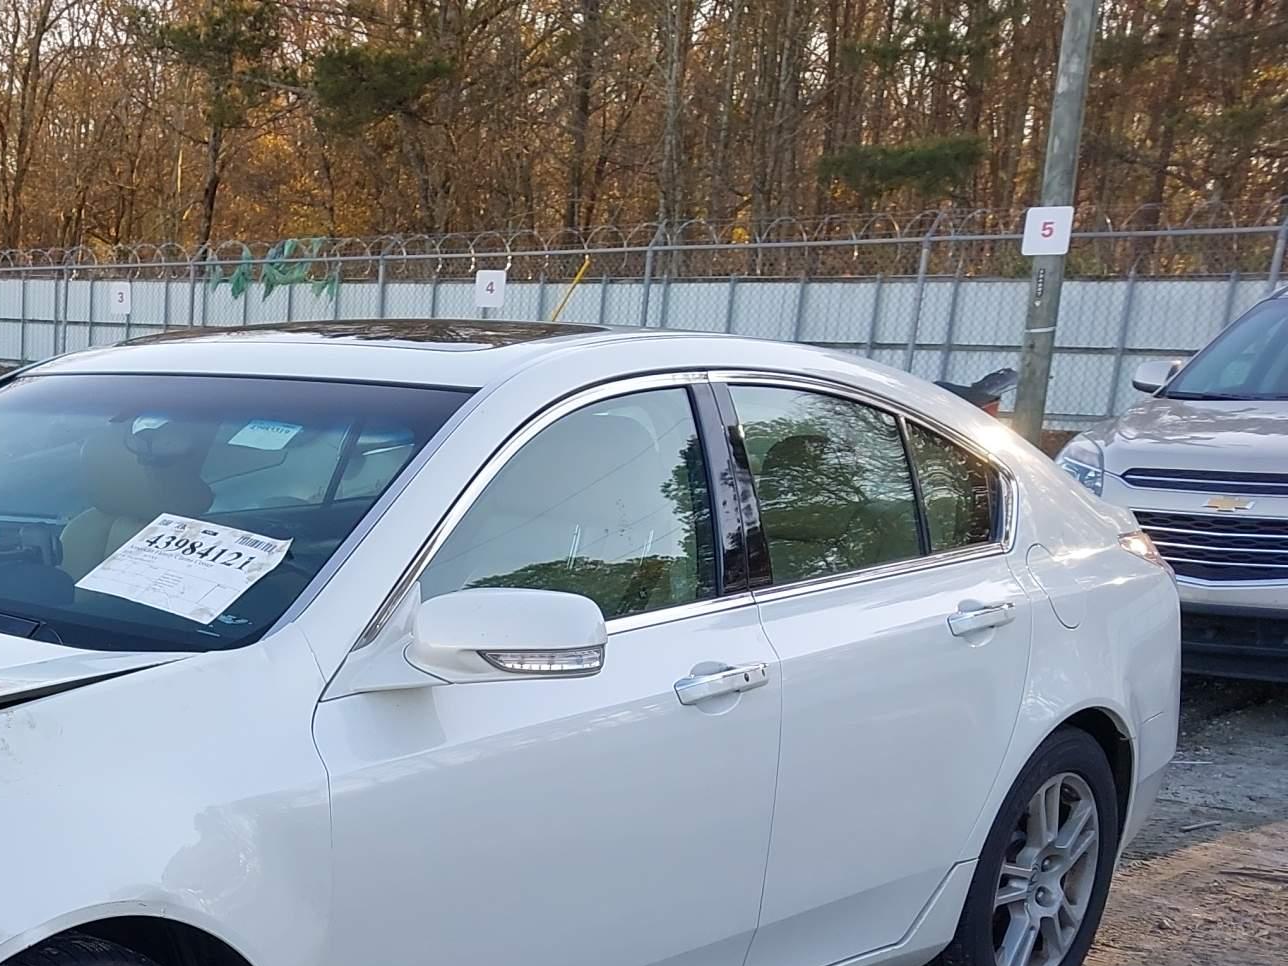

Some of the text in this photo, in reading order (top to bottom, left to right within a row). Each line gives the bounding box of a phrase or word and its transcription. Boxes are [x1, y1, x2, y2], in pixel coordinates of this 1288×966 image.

[1041, 221, 1054, 238] 5
[486, 281, 495, 294] 4
[117, 291, 124, 304] 3
[145, 533, 256, 570] 43984121
